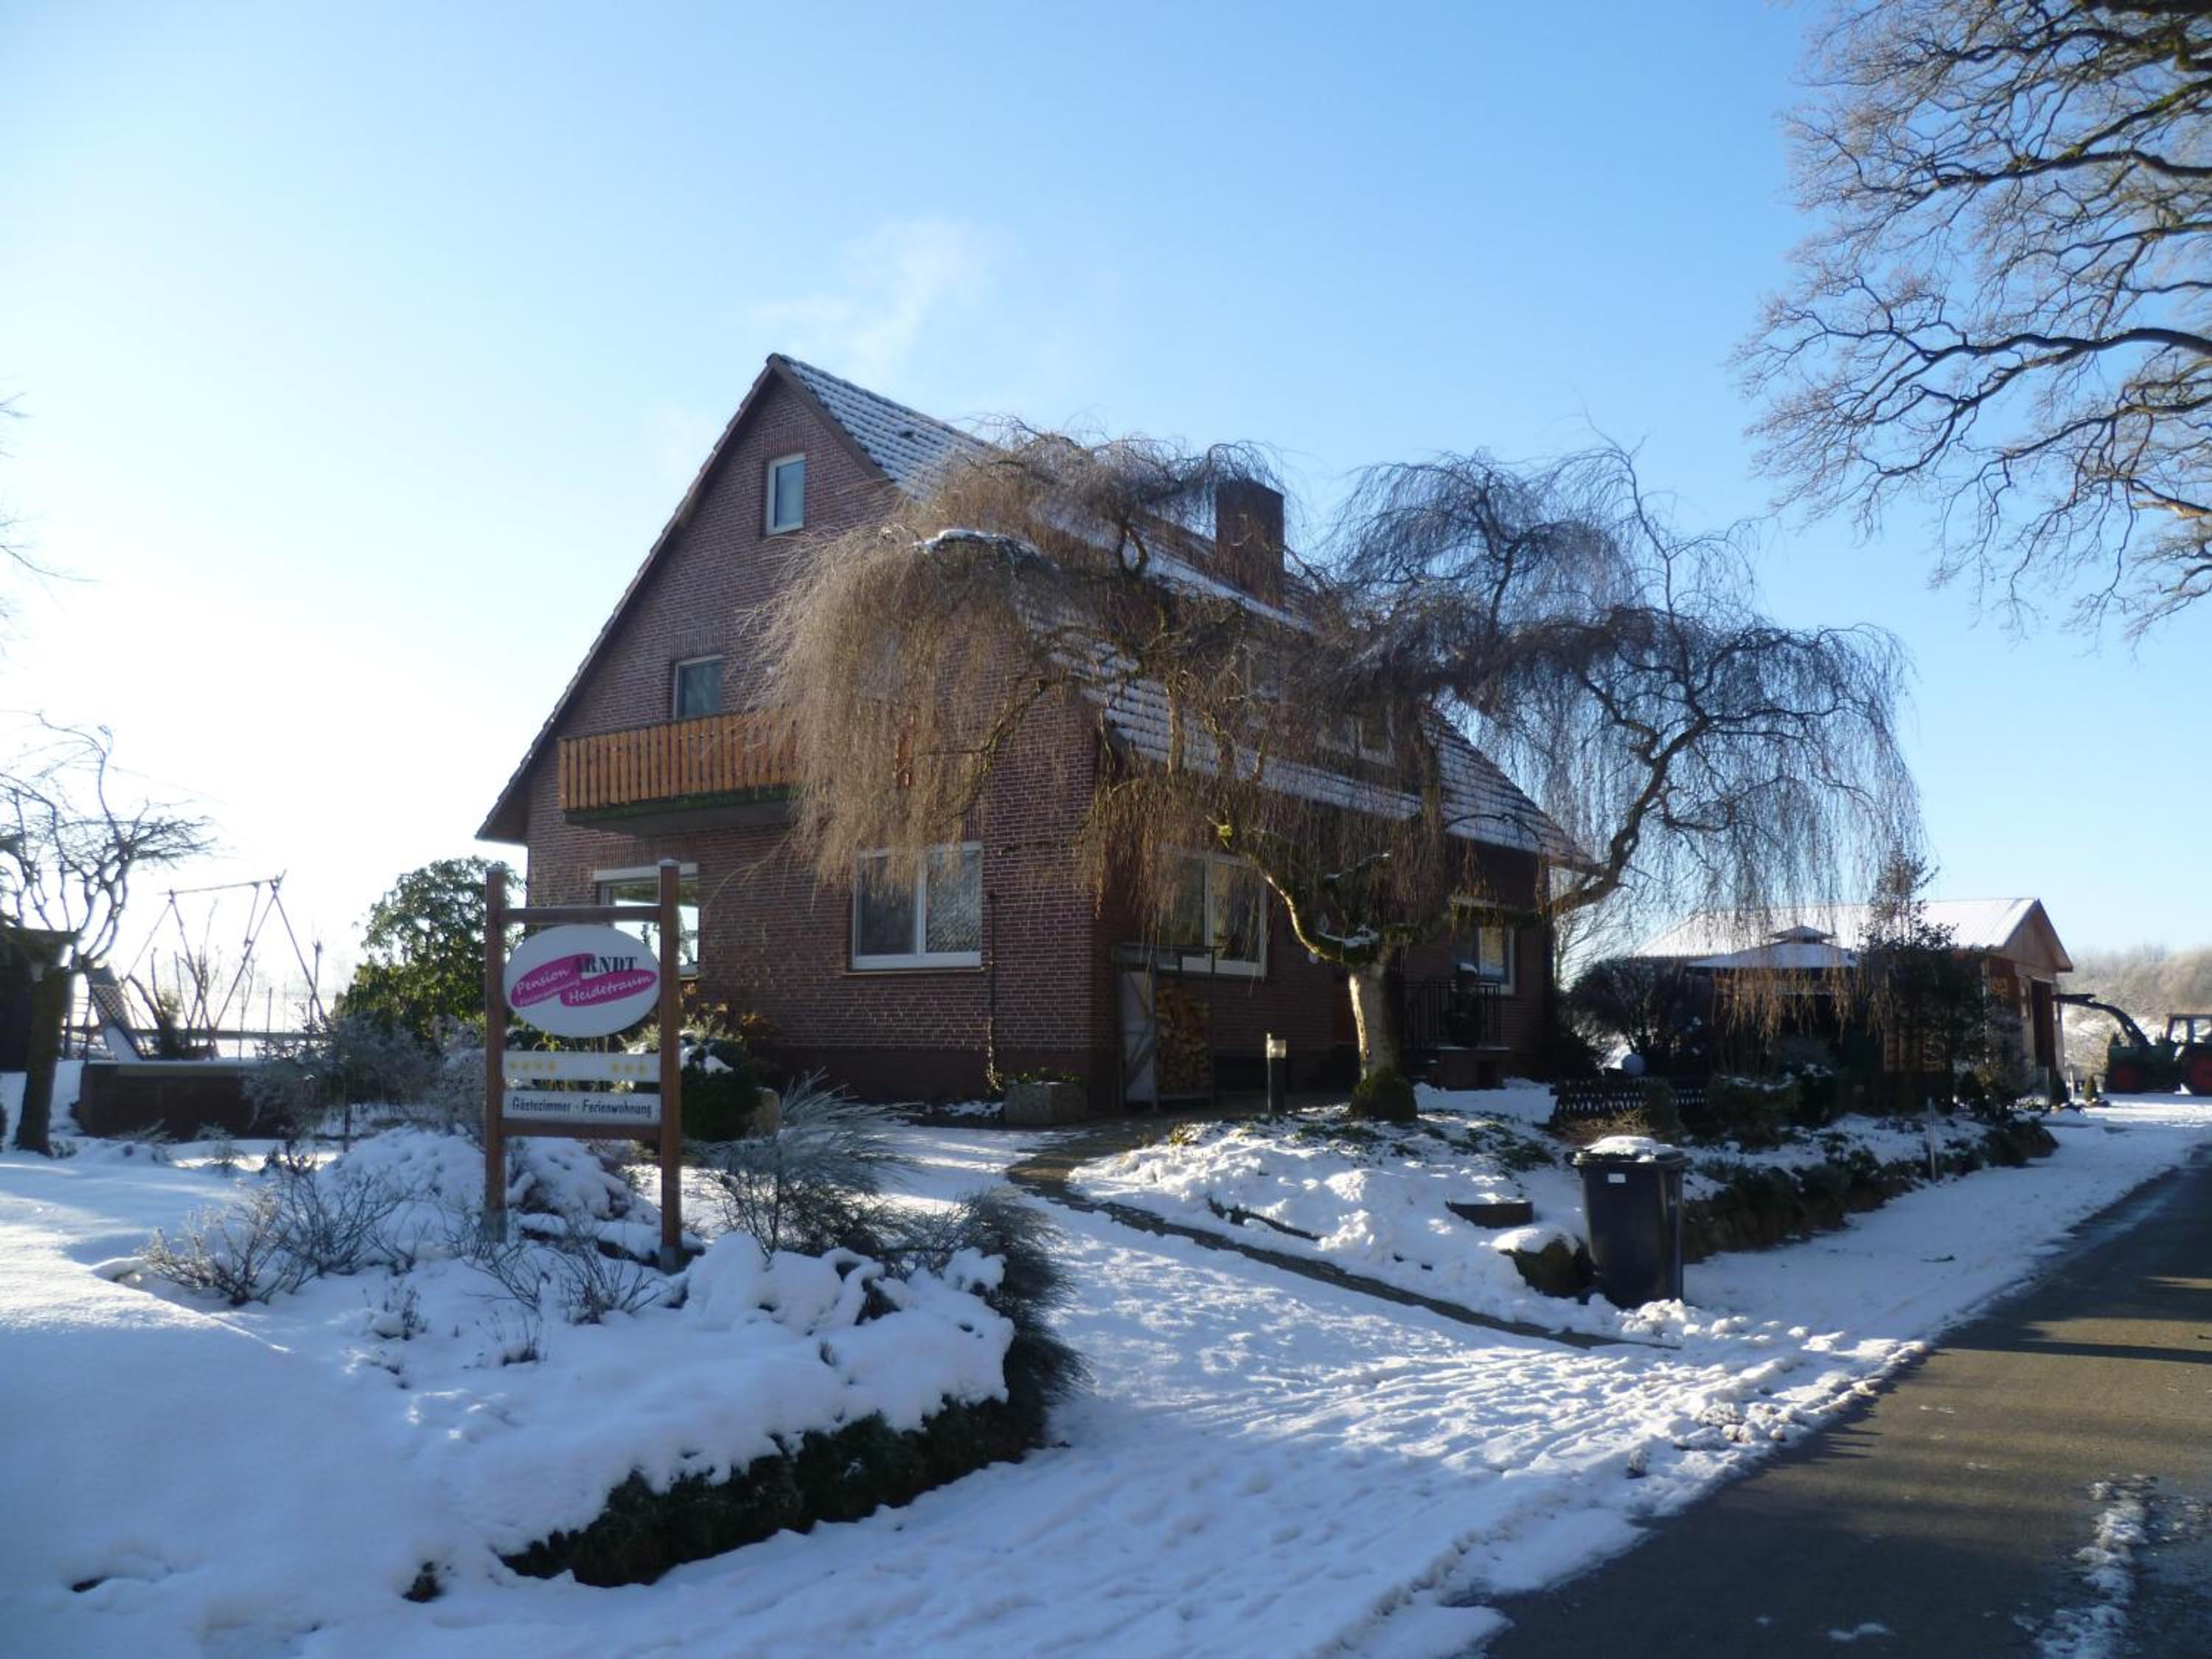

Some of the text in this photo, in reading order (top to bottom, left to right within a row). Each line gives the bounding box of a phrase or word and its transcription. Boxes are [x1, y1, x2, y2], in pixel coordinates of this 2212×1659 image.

[577, 956, 637, 973] ARNDT
[517, 968, 568, 995] Pension
[569, 975, 651, 1004] Heidetraum
[512, 1096, 571, 1111] Gästezimmer
[582, 1099, 652, 1117] Ferienwohnung
